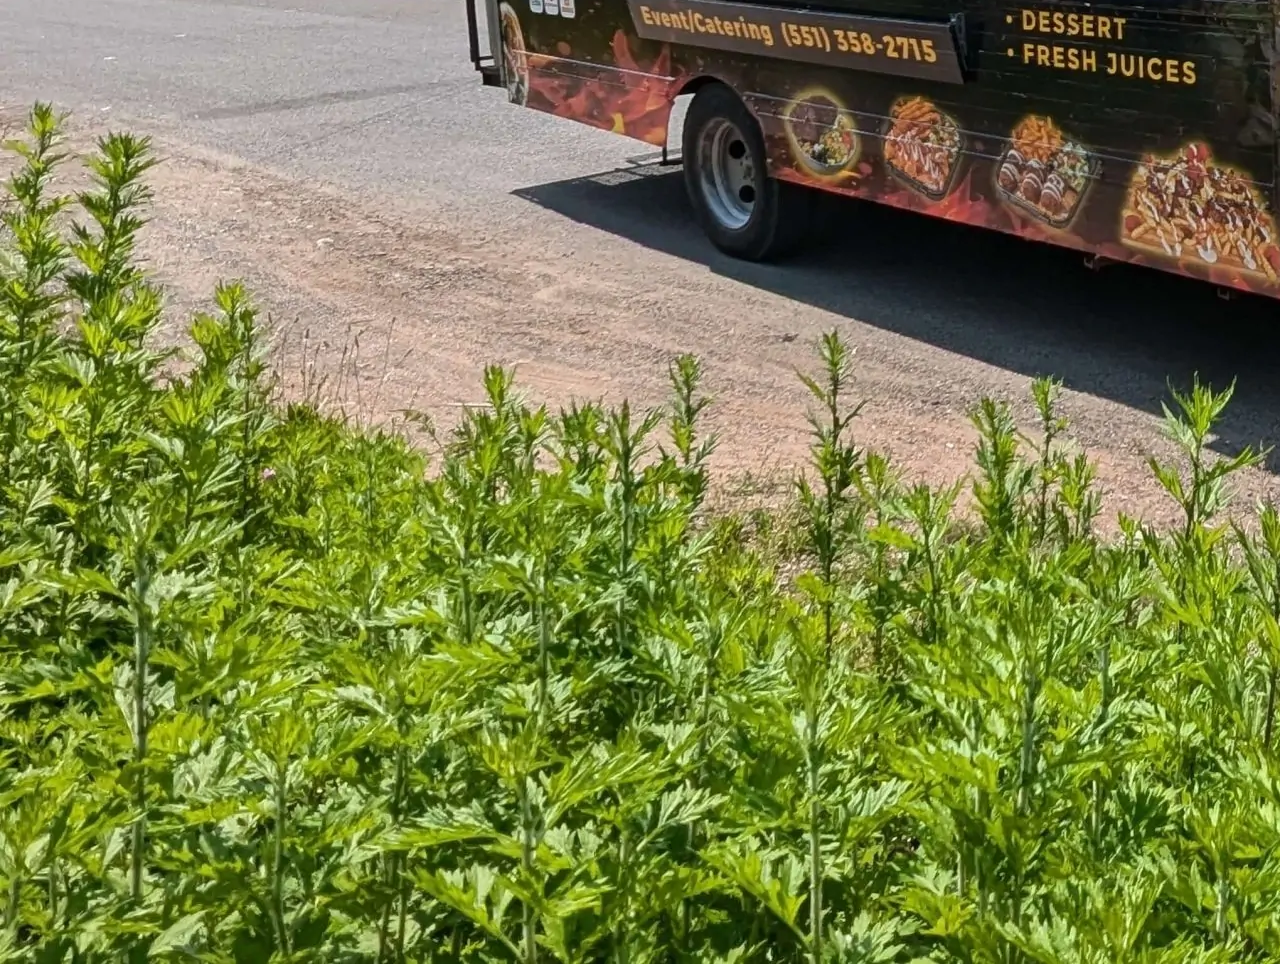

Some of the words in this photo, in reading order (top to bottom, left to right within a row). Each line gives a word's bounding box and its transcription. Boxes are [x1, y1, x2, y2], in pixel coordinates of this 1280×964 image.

[639, 5, 774, 47] Event/Catering
[781, 22, 831, 53] (551)
[833, 29, 938, 64] 358-2715
[1022, 9, 1127, 40] DESSERT
[1023, 43, 1097, 72] FRESH
[1107, 52, 1197, 84] JUICES
